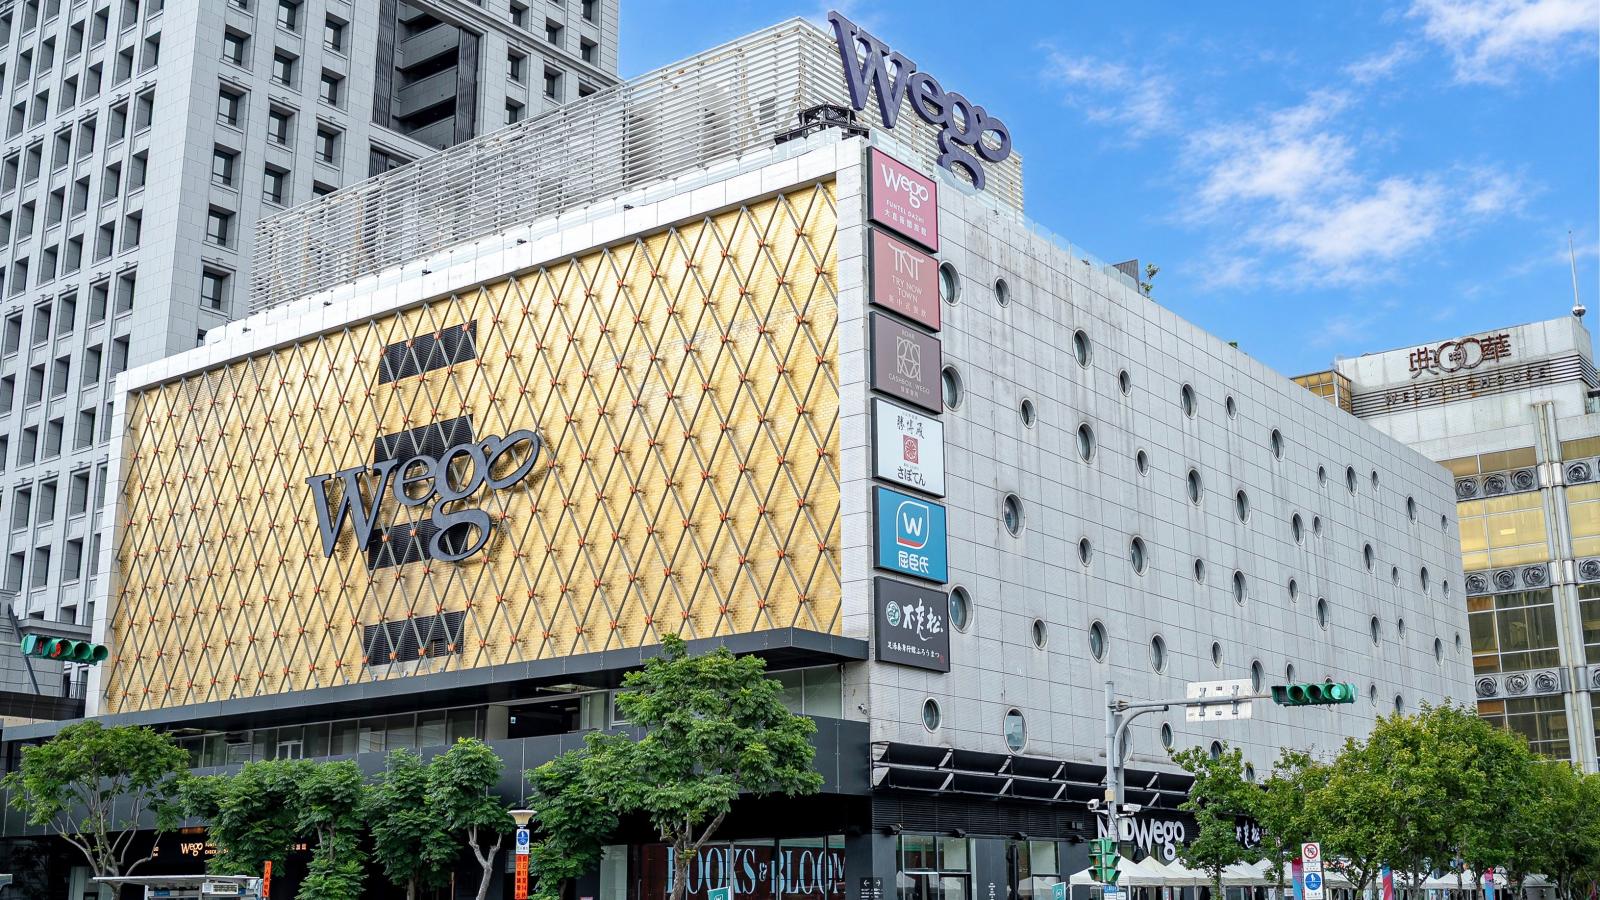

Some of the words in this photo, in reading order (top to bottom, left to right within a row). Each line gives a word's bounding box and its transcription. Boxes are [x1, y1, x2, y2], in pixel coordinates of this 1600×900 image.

[828, 11, 1011, 191] Wego
[881, 161, 929, 209] Wego
[888, 242, 925, 281] TNT
[892, 275, 905, 288] TRY
[906, 282, 923, 296] NOW
[898, 286, 918, 303] TOWN
[897, 466, 926, 487] さぼてん
[305, 429, 541, 562] Wego
[903, 512, 923, 537] W
[898, 550, 929, 574] 屈臣氏
[181, 842, 203, 857] Wego
[759, 862, 767, 881] &
